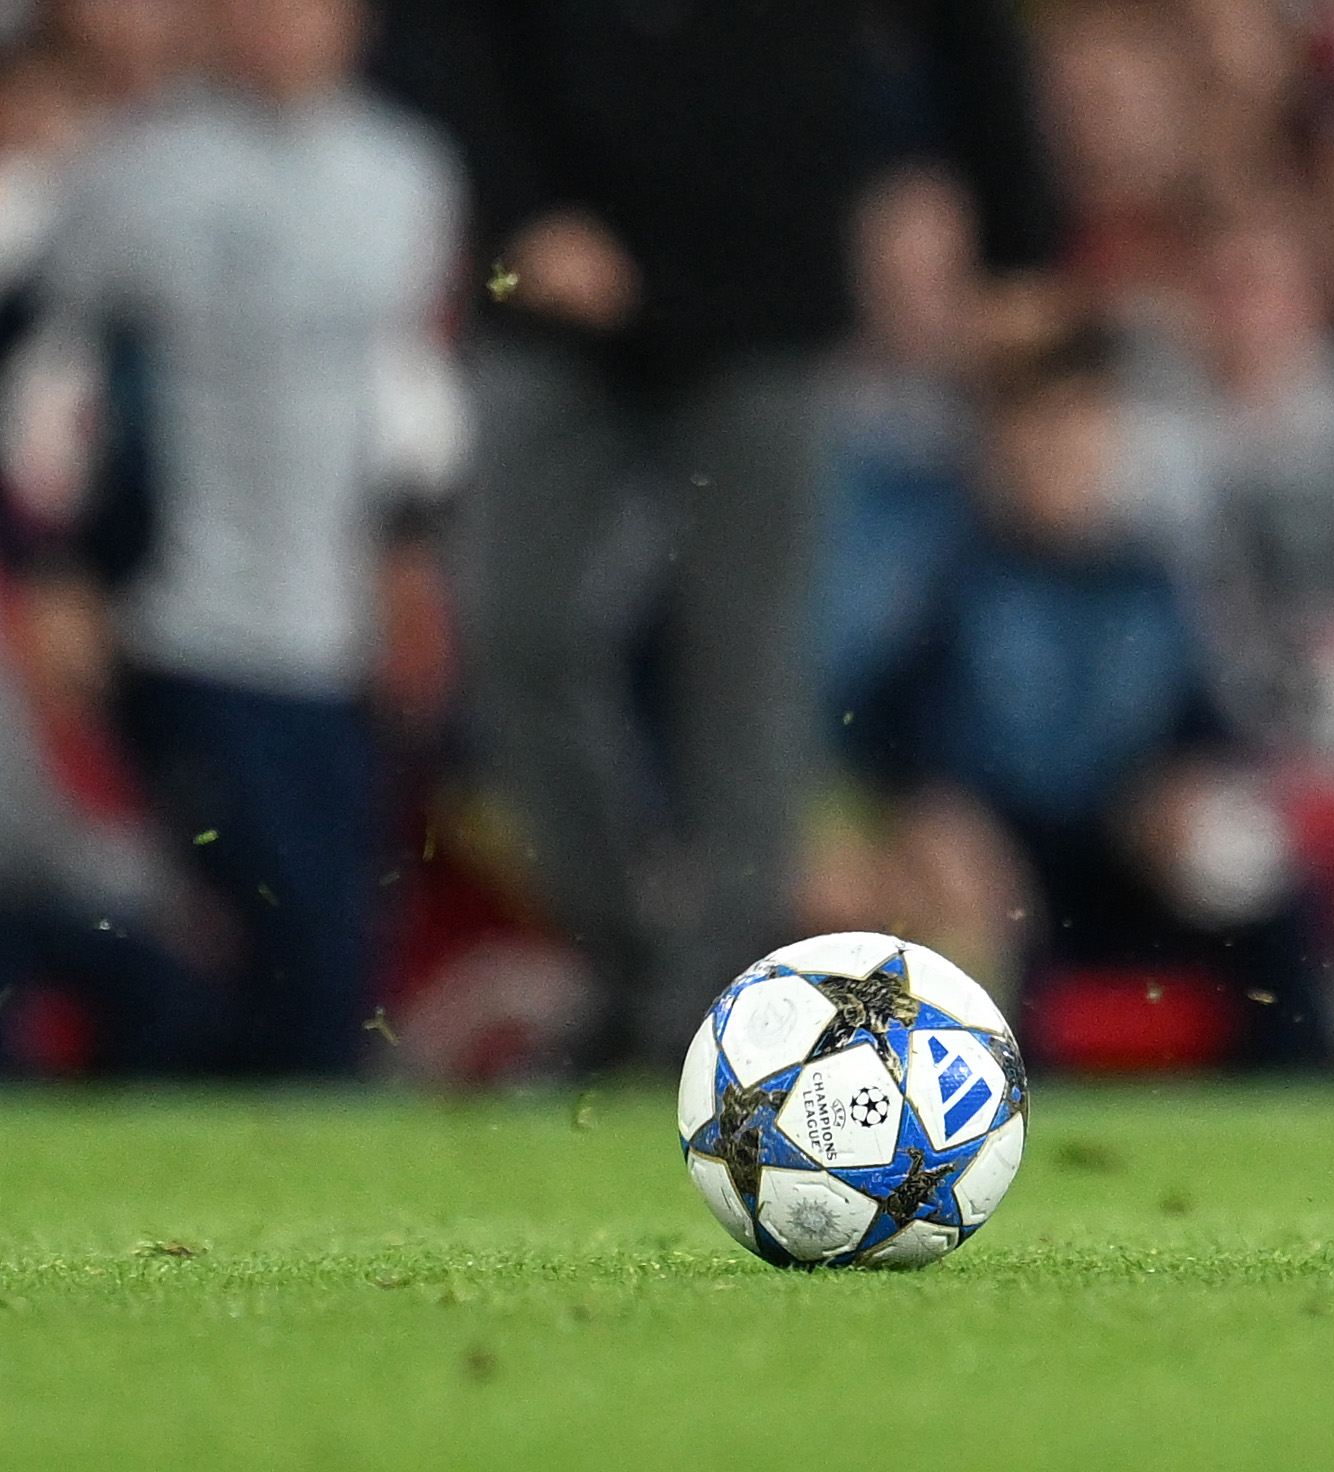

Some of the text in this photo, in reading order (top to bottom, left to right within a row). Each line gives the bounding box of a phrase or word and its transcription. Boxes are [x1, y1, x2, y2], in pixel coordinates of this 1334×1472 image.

[802, 1090, 821, 1149] LEAGUE
[812, 1071, 838, 1161] CHAMPIONS
[832, 1099, 844, 1128] UEFA
